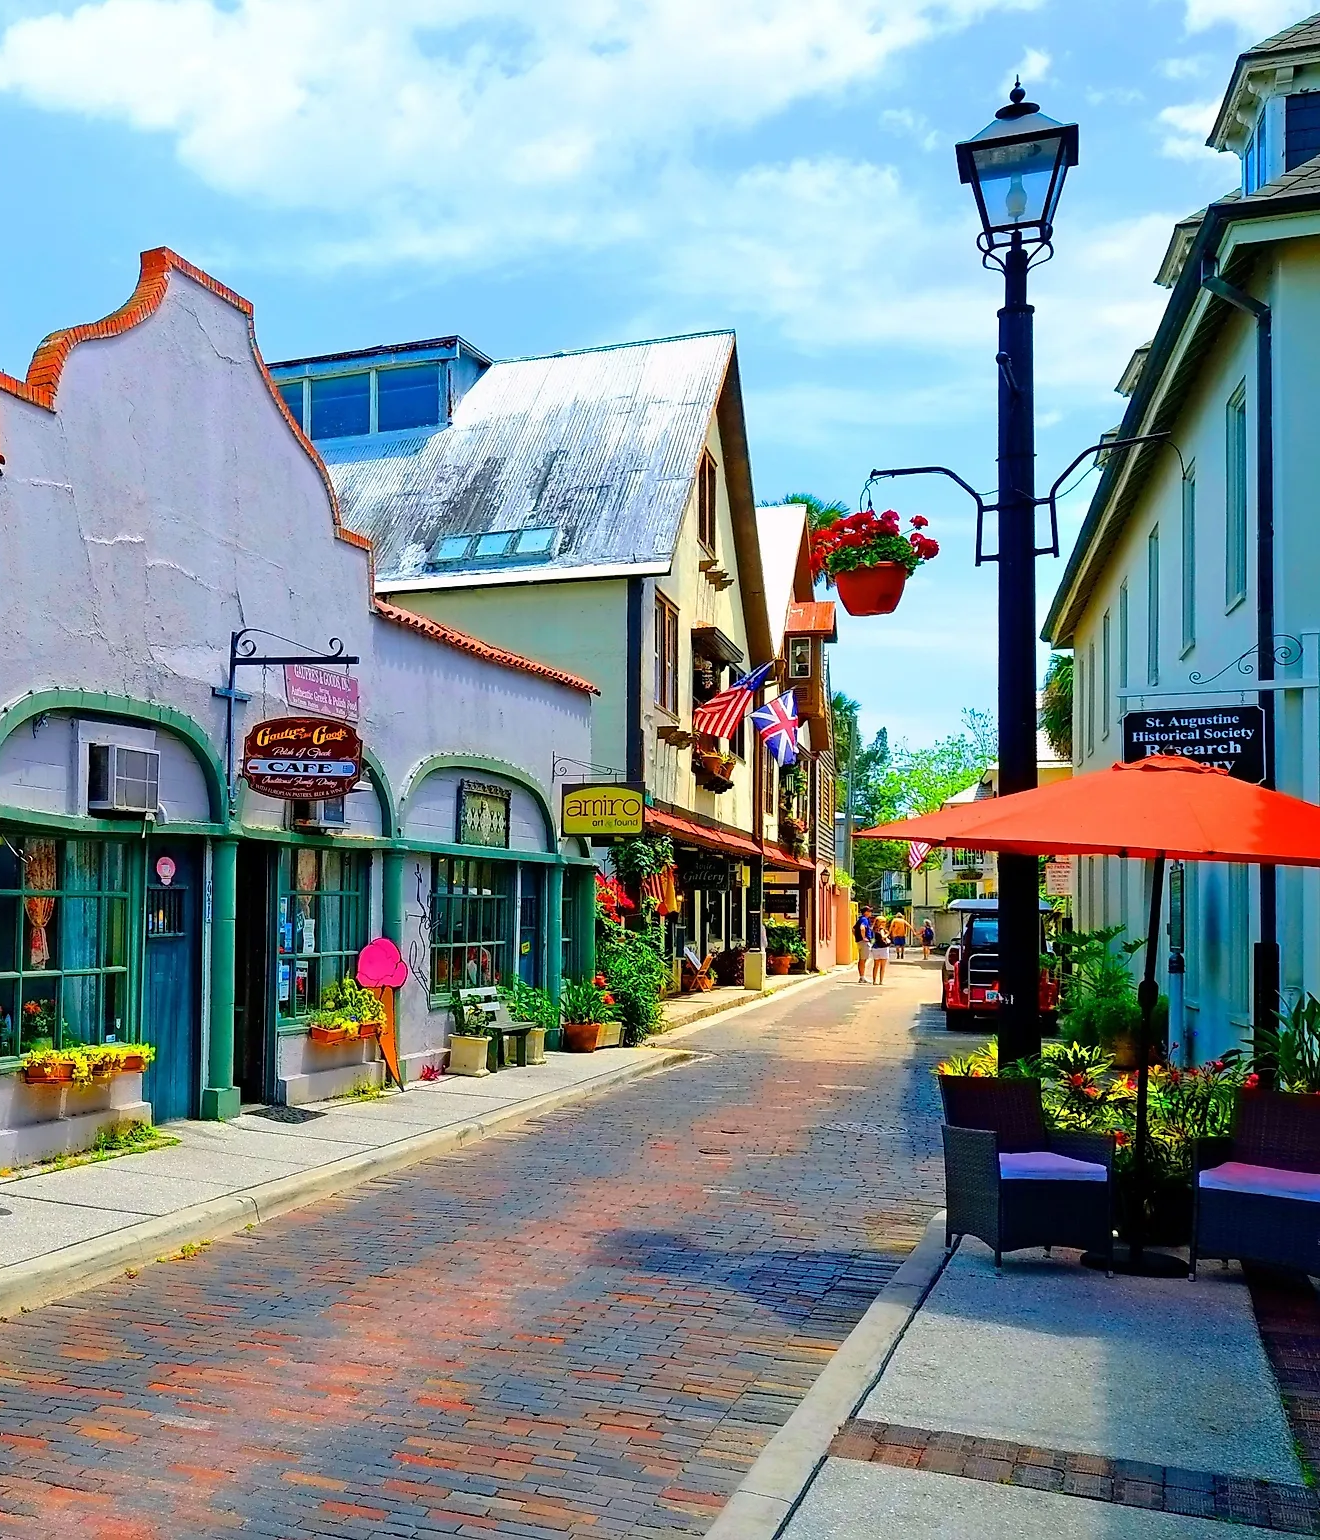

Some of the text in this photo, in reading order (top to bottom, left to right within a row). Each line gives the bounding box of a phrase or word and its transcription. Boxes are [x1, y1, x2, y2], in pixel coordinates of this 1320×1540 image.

[313, 691, 329, 704] Greek
[332, 696, 347, 709] Polish
[1145, 713, 1240, 729] St. Augustine
[1132, 727, 1255, 743] Historical Society
[272, 746, 294, 756] Polish
[307, 747, 332, 758] Greek
[1144, 740, 1242, 757] Rsearch
[267, 762, 333, 773] CAFE
[261, 775, 338, 789] Traditional Family Dining
[255, 783, 267, 792] WITH
[267, 787, 292, 797] EUROPEAN
[330, 787, 343, 795] WINE
[566, 794, 641, 817] amiro
[592, 819, 604, 827] art
[614, 818, 638, 827] found
[682, 869, 725, 884] Gallery
